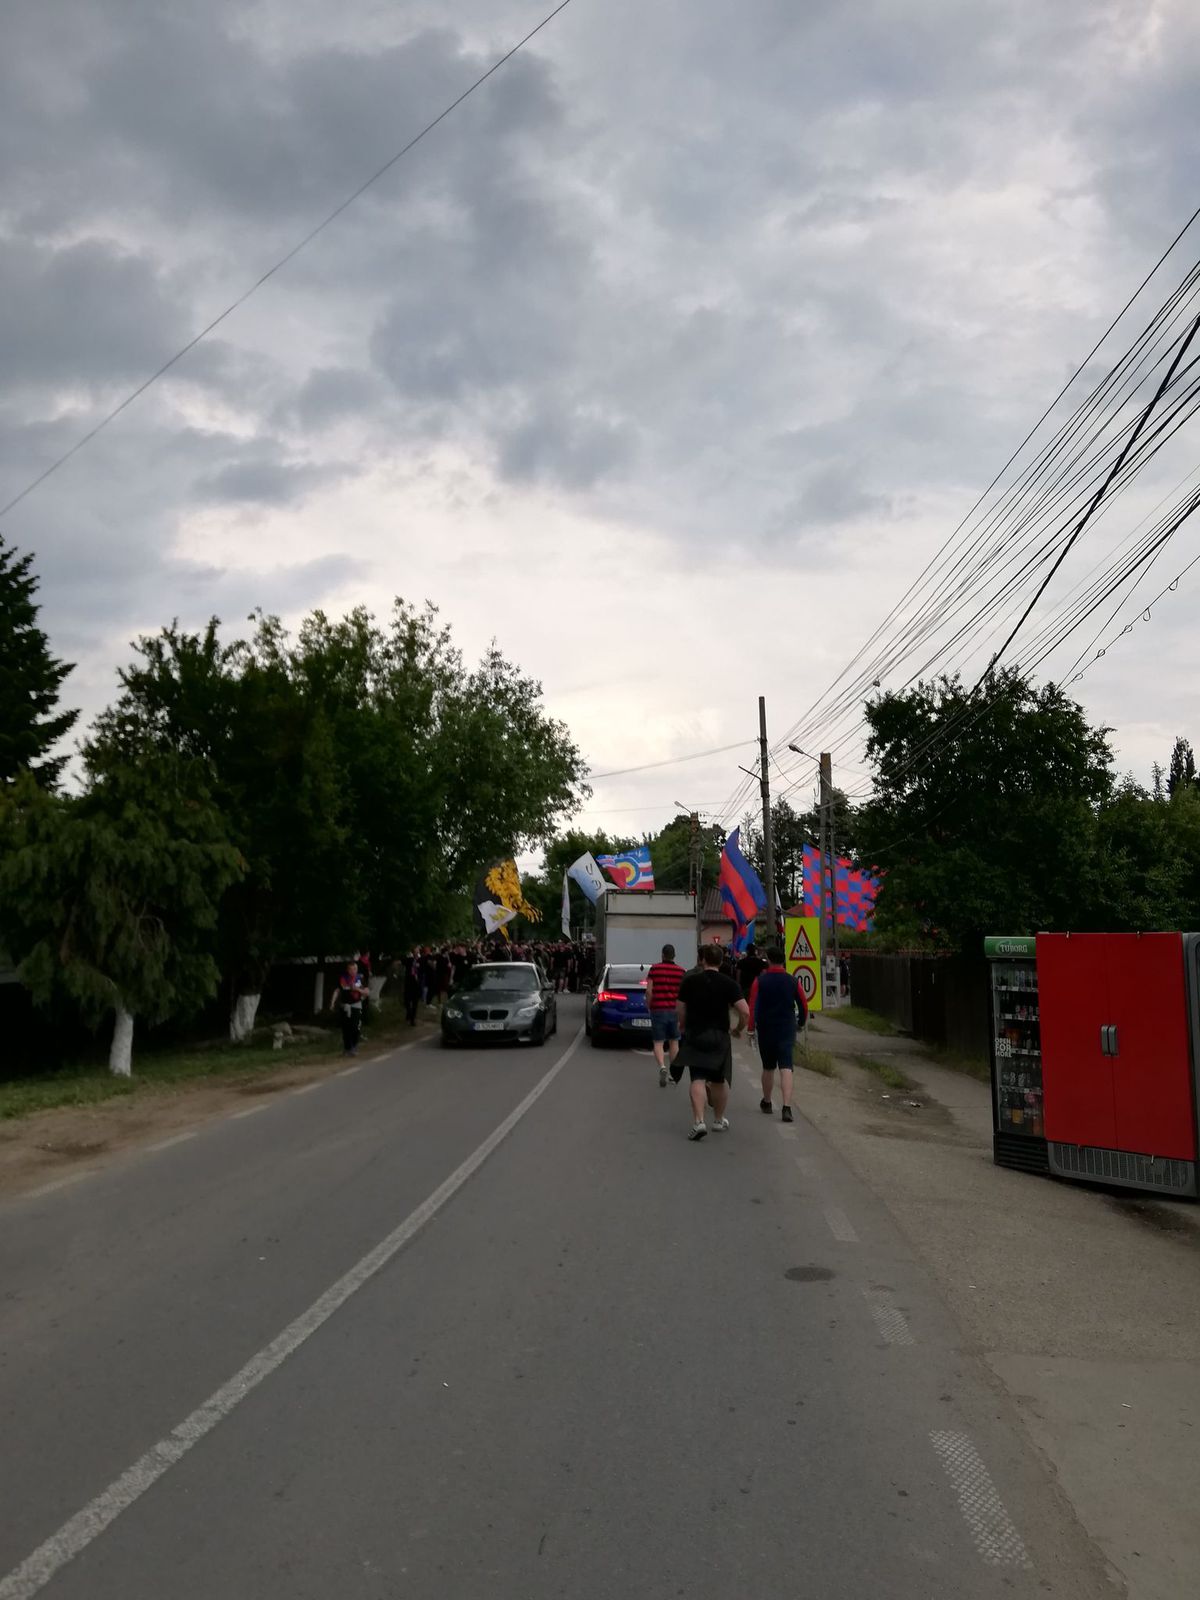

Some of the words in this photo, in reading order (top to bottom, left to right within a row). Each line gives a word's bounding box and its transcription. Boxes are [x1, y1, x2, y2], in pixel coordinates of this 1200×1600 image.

[1000, 944, 1028, 953] TUBORG
[995, 1043, 1012, 1051] FOR
[995, 1050, 1013, 1058] MORE
